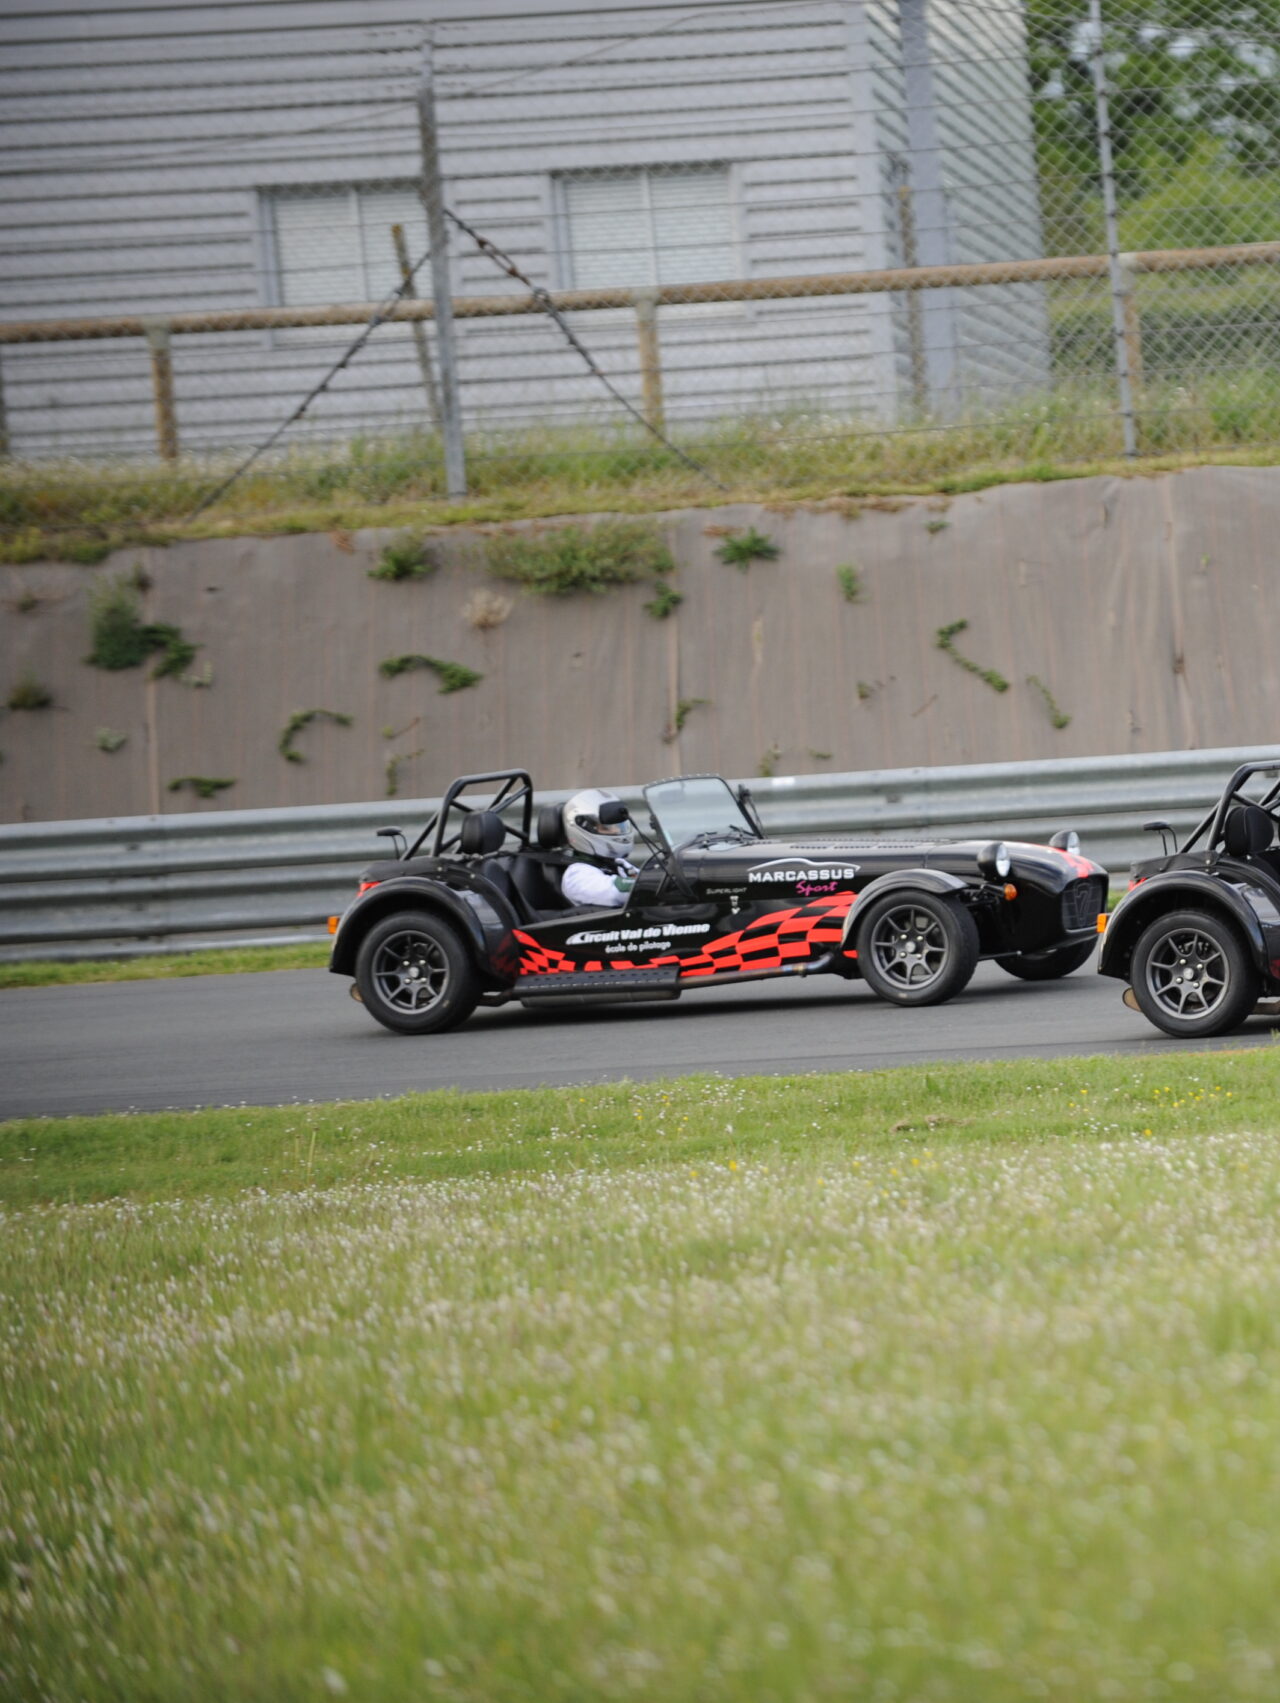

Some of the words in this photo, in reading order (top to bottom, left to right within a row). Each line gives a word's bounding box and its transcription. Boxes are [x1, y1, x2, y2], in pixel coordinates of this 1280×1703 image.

[748, 868, 855, 883] MARCASSUS
[796, 880, 839, 896] Sport
[565, 930, 620, 945] Circuit
[620, 928, 642, 940] Val
[643, 926, 662, 938] de
[662, 923, 711, 936] Vienne
[605, 943, 626, 954] école
[627, 941, 638, 952] de
[639, 940, 672, 952] pilotage
